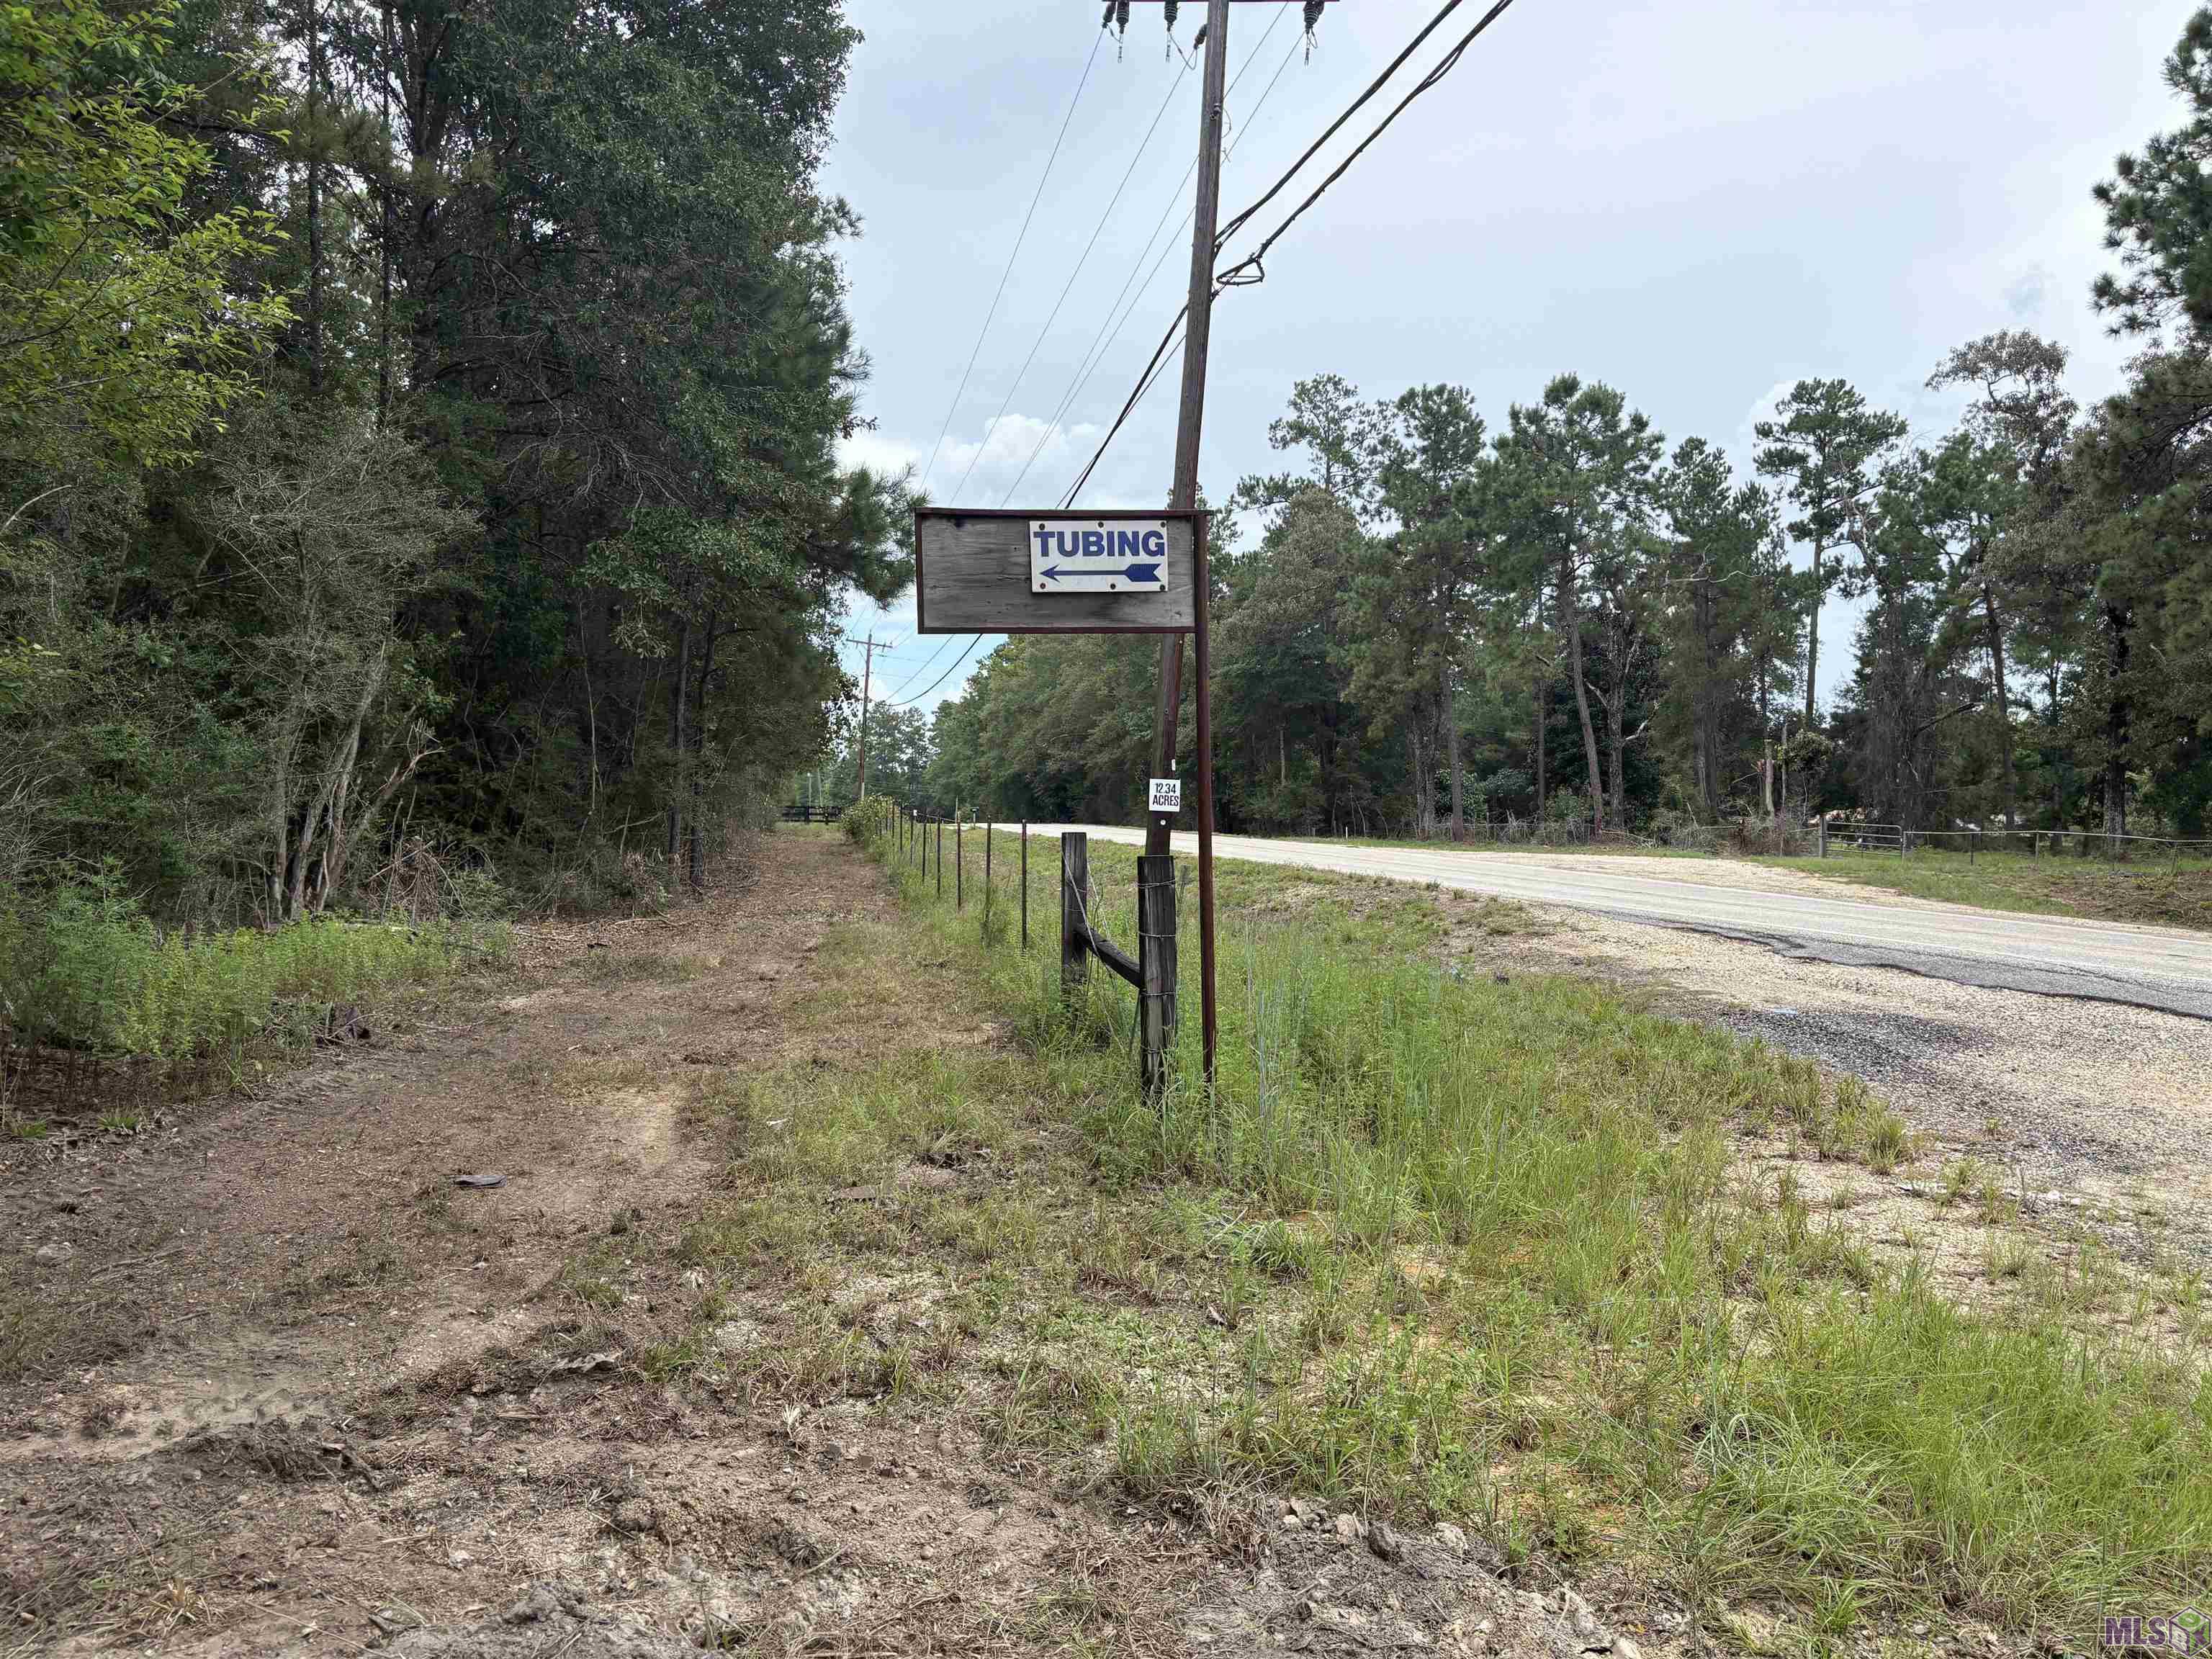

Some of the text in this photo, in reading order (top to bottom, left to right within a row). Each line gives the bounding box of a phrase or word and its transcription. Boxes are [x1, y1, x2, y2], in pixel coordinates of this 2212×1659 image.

[1033, 530, 1165, 557] TUBING
[1154, 783, 1177, 794] 12.34
[1152, 794, 1179, 806] ACRES
